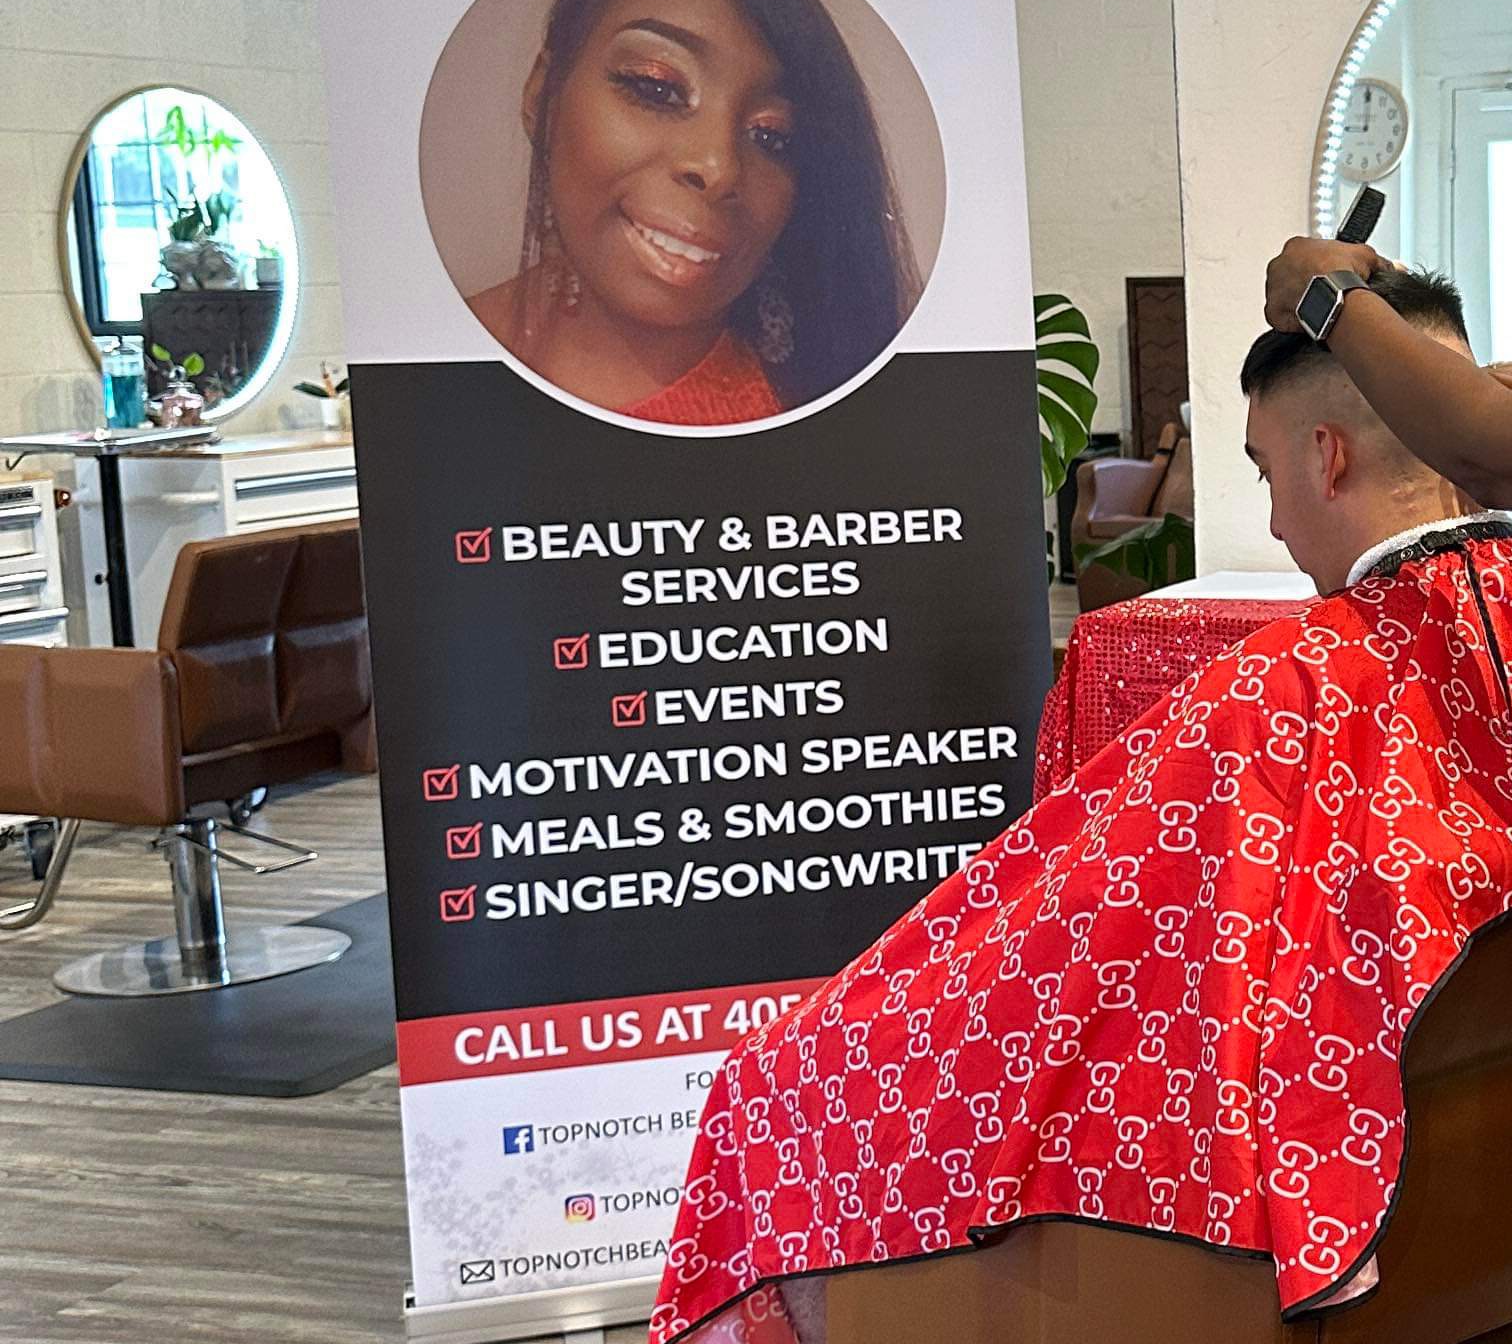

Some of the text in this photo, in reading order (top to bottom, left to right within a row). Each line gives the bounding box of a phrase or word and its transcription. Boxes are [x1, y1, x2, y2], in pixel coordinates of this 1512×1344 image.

[502, 508, 963, 562] BEAUTY & BARBER
[621, 561, 860, 606] SERVICES
[598, 618, 888, 668] EDUCATION
[655, 679, 844, 725] EVENTS
[469, 726, 1018, 799] MOTIVATION SPEAKER
[491, 783, 1005, 859] MEALS & SMOOTHIES
[485, 842, 989, 920] SINGER/SONGWRITE
[454, 1020, 568, 1065] CALL
[581, 1010, 643, 1052] US
[655, 1003, 712, 1045] AT
[538, 1113, 662, 1145] TOPNOTCH
[600, 1186, 684, 1213] TOPNO
[500, 1238, 672, 1278] TOPNOTCHBEA
